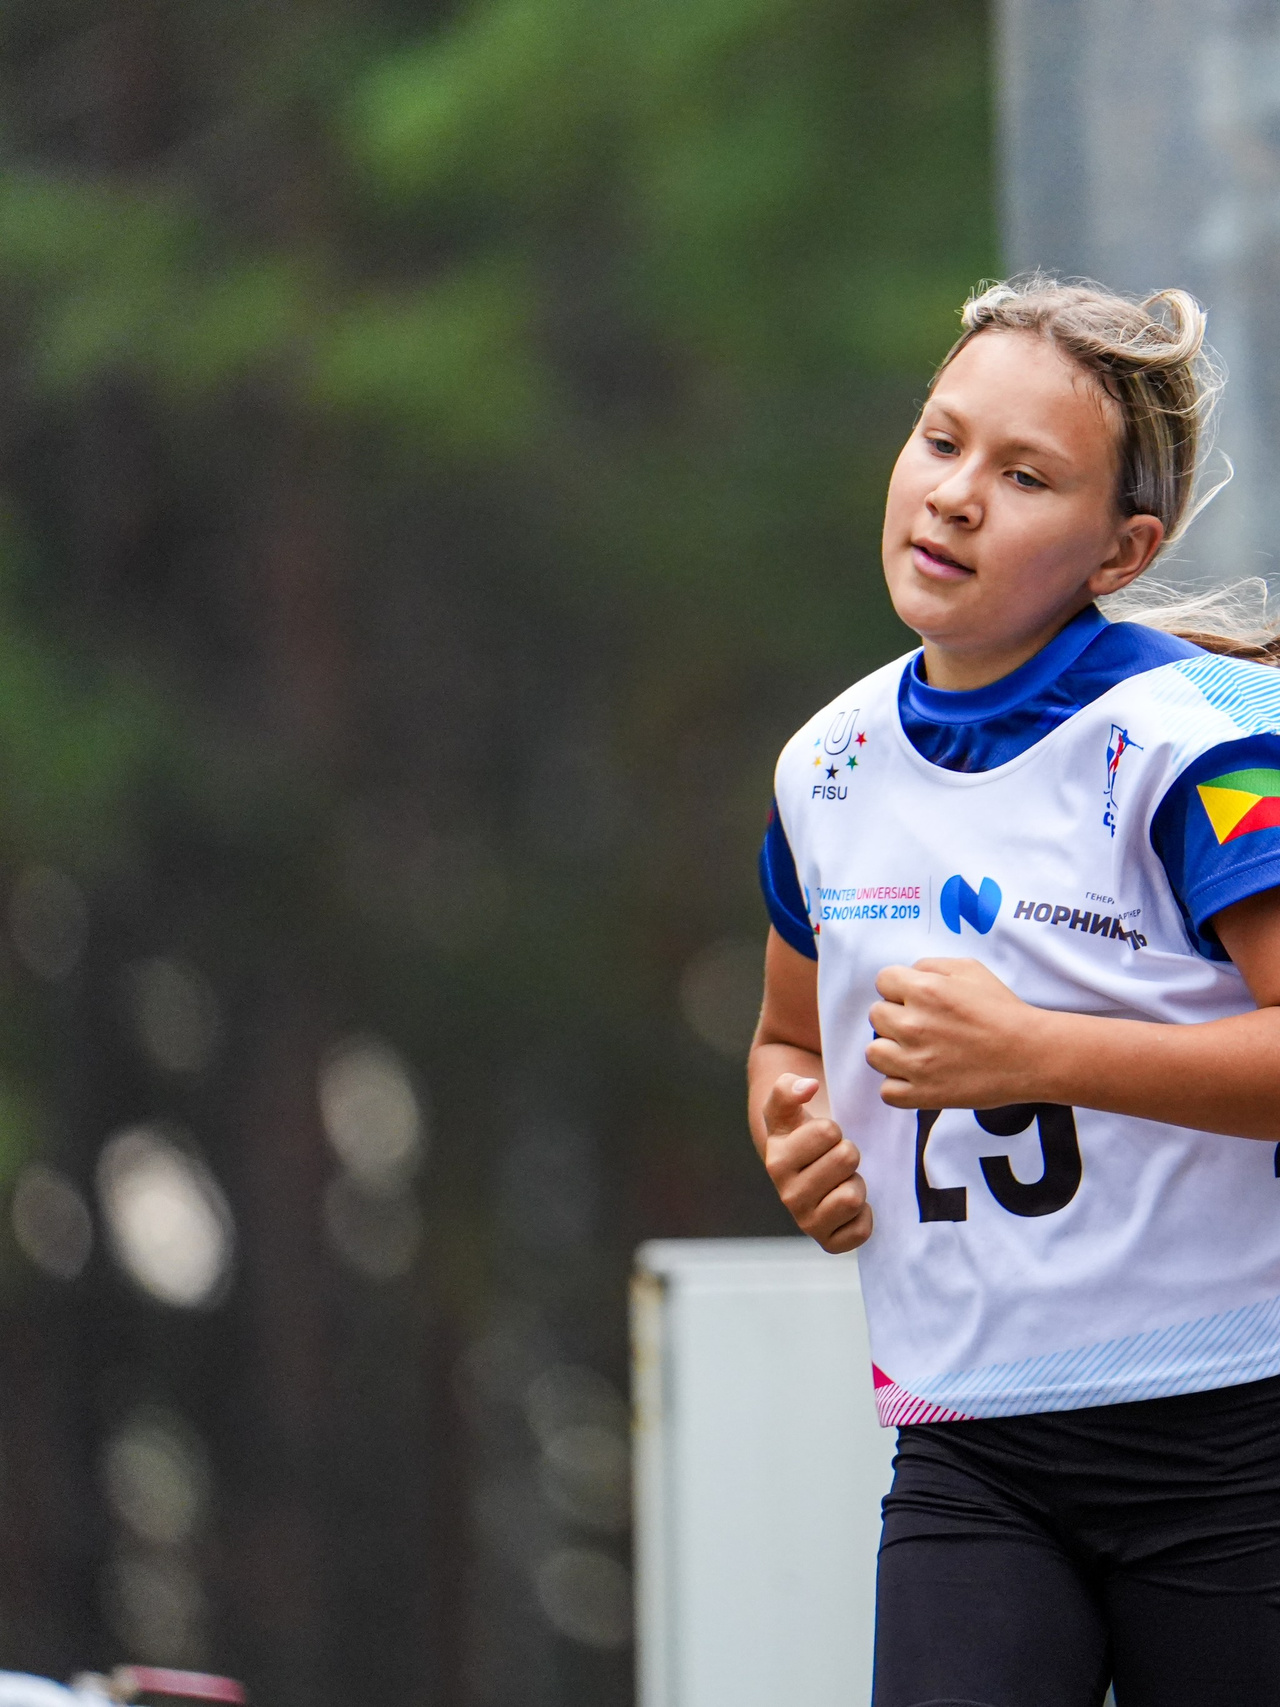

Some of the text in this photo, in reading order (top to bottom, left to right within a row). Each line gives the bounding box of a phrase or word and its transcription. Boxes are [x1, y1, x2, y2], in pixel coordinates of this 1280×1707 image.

[812, 785, 848, 800] FISU
[1085, 891, 1115, 905] ГЕНЕР
[820, 904, 920, 920] SNOYARSK 2019
[1118, 908, 1142, 920] АРТНЕР
